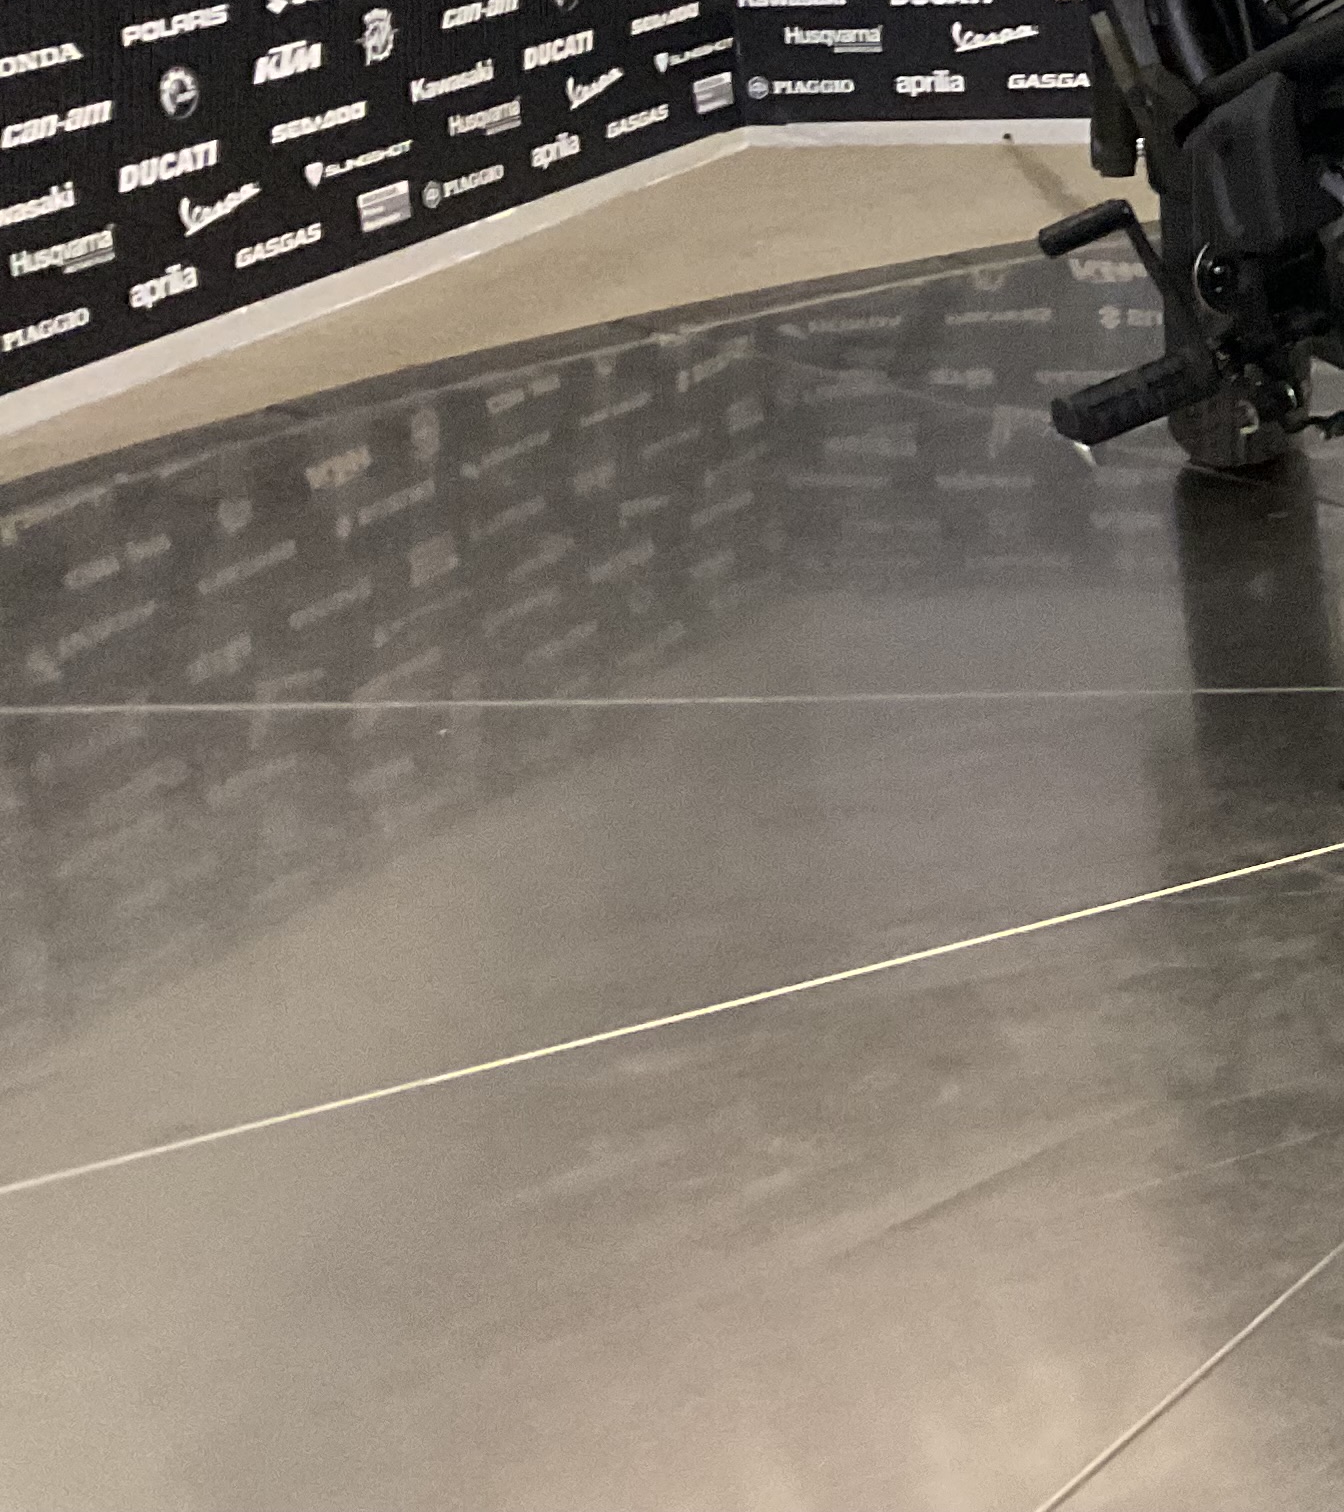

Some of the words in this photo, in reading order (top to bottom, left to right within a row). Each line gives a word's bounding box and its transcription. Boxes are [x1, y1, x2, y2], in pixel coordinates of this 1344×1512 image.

[122, 4, 229, 47] POLARIS
[784, 25, 882, 46] Husqvarna
[952, 22, 1039, 52] Vespa
[0, 43, 83, 77] ONDA
[254, 40, 321, 84] KTM
[524, 30, 593, 70] DUCATI
[772, 80, 854, 94] PIAGGIO
[896, 70, 965, 97] aprilia
[1008, 73, 1090, 89] GASGA
[606, 104, 668, 138] GASGAS
[119, 140, 218, 192] DUCATI
[443, 165, 504, 197] PIAGGIO
[235, 223, 321, 268] GASGAS
[1, 308, 89, 352] PIAGGIO
